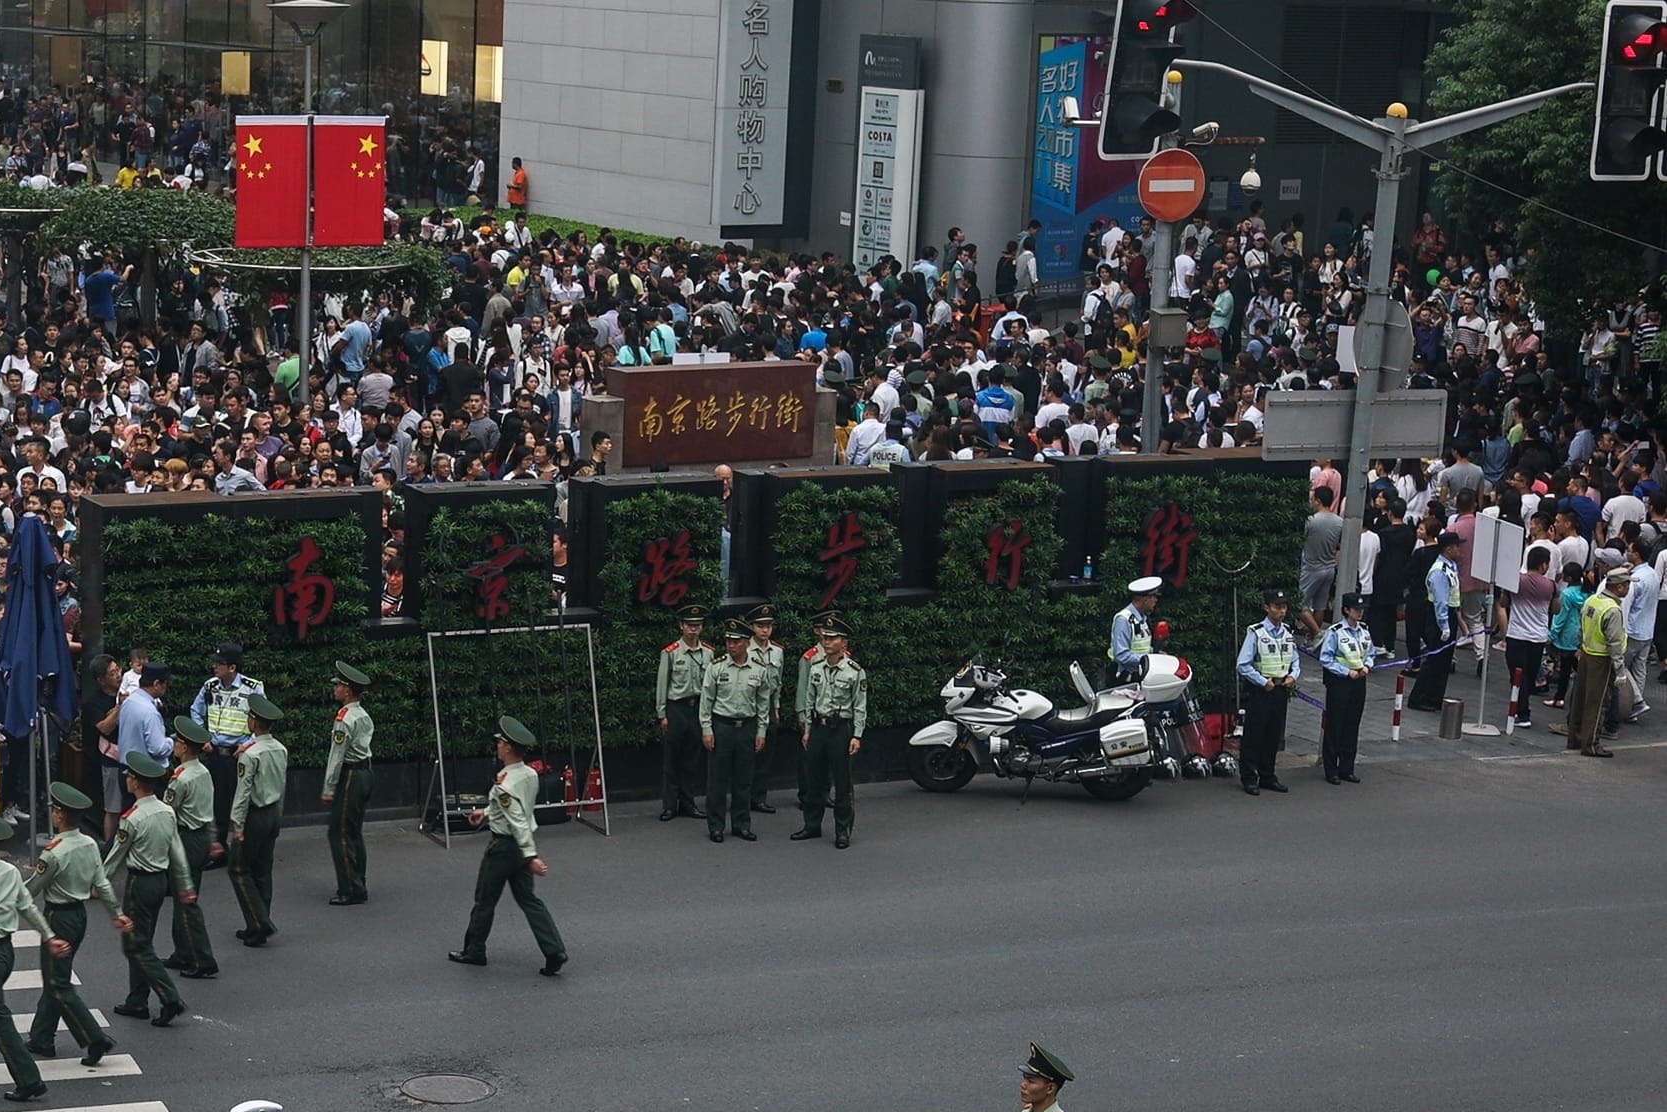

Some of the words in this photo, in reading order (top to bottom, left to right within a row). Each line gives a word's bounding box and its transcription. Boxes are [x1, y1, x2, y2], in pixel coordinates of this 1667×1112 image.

[734, 2, 769, 215] 名人购物中心
[868, 130, 892, 142] COSTA
[639, 390, 803, 442] 南京路步行街
[872, 451, 897, 461] POLICE
